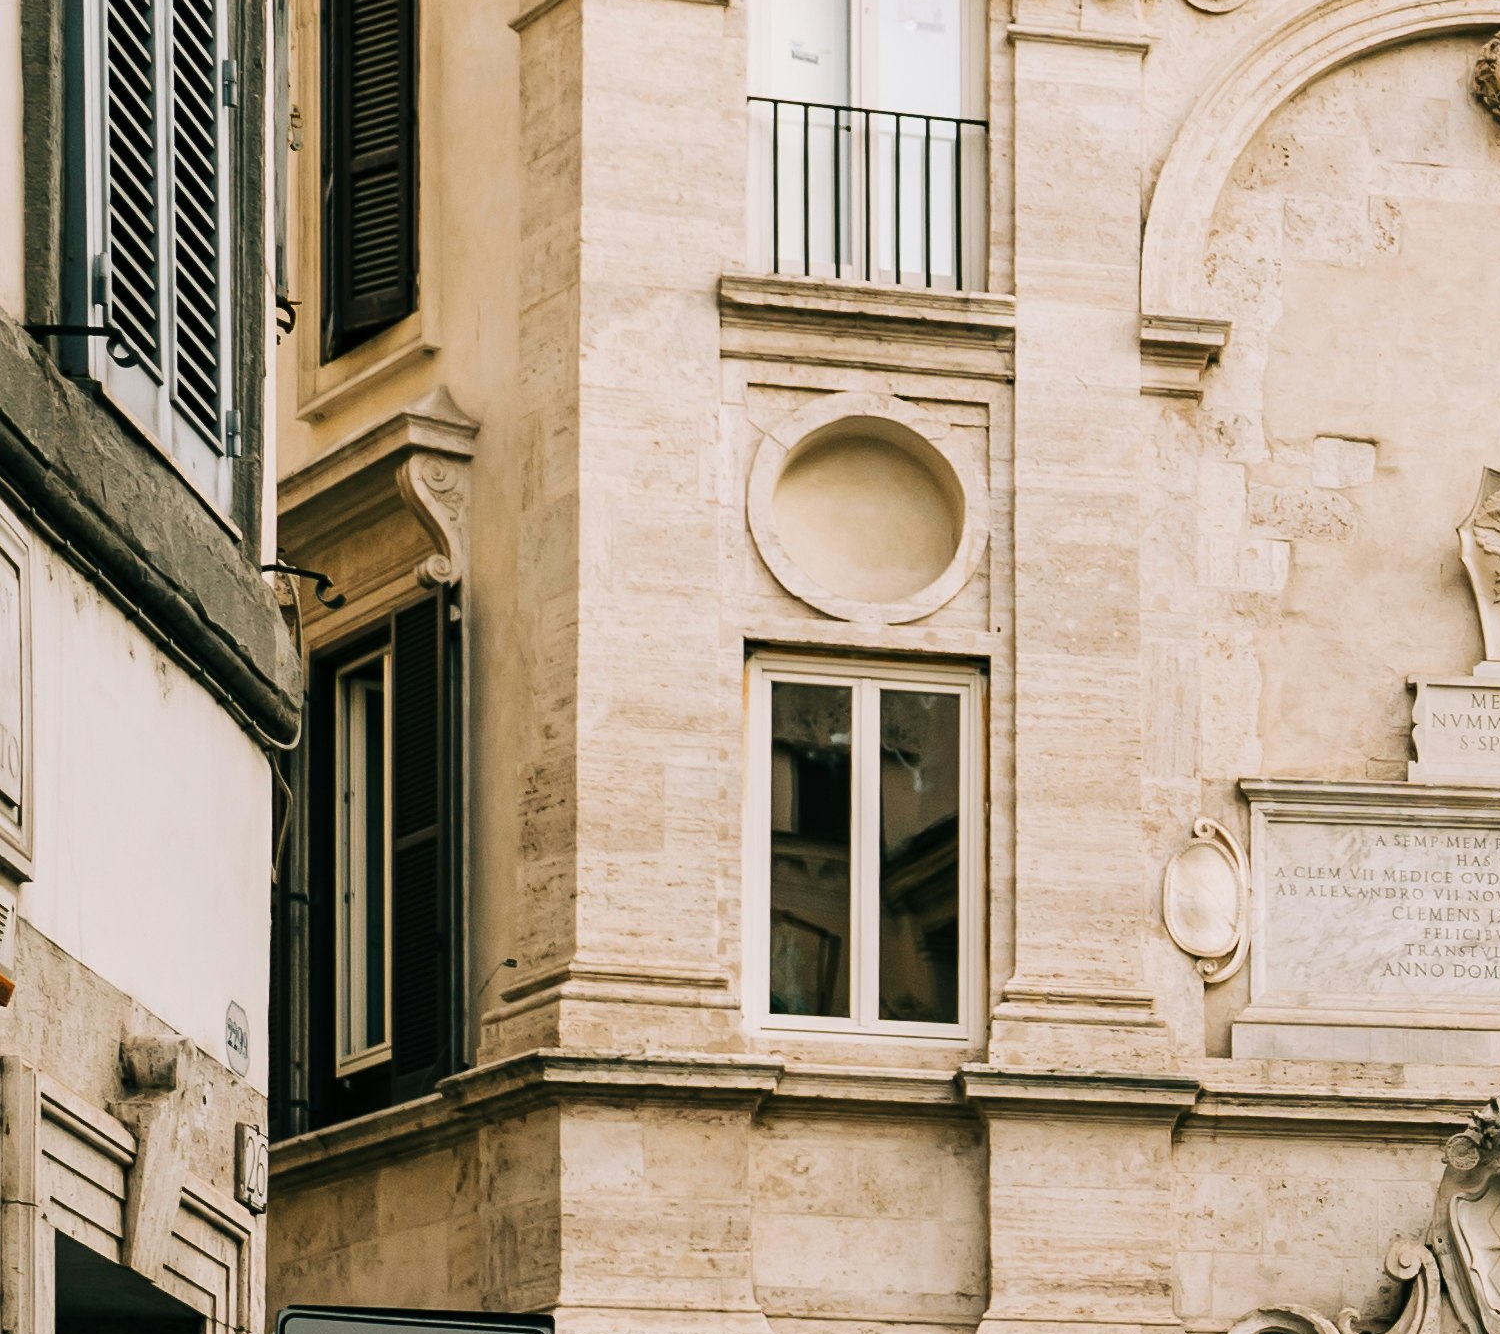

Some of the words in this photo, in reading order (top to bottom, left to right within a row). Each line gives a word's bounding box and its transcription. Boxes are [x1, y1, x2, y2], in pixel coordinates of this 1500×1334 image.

[1375, 835, 1387, 847] A
[1456, 854, 1491, 867] HAS
[1274, 866, 1286, 878] A
[1382, 868, 1453, 884] MEDICE
[1275, 883, 1298, 897] AB
[1305, 884, 1424, 900] ALEXANDRO
[1434, 888, 1460, 901] VII
[1391, 906, 1481, 923] CLEMENS
[1380, 962, 1445, 978] ANNO
